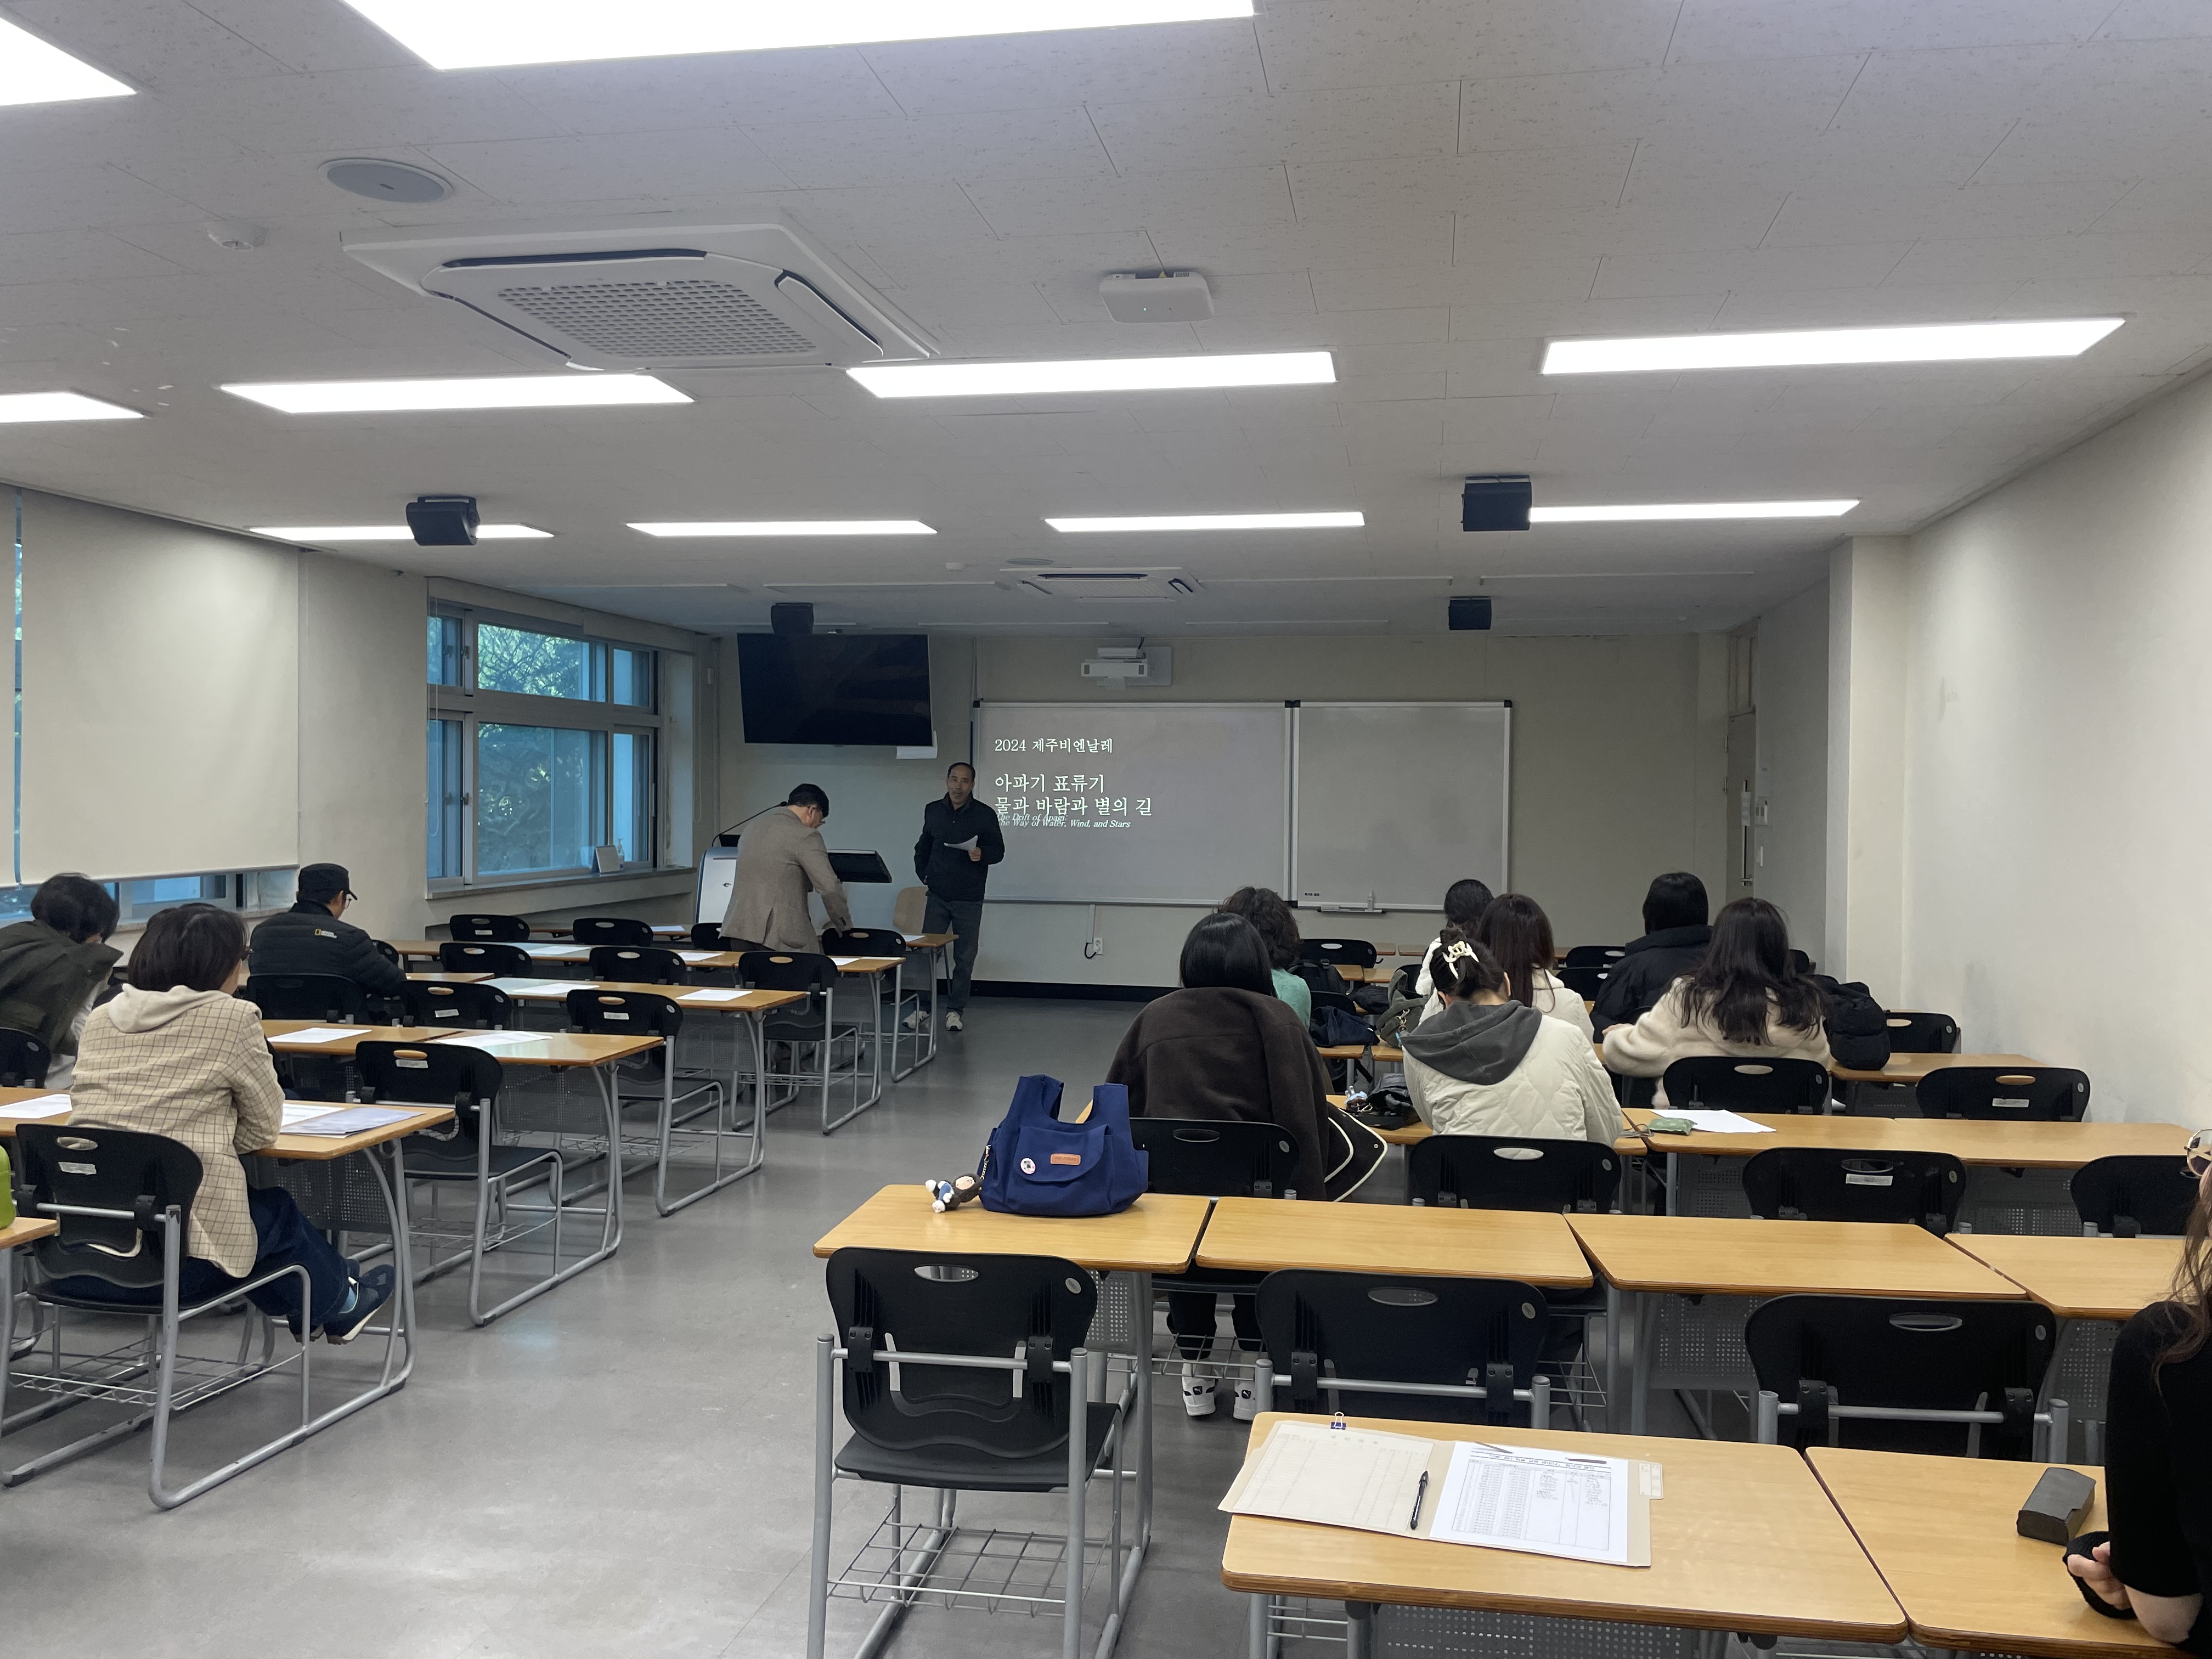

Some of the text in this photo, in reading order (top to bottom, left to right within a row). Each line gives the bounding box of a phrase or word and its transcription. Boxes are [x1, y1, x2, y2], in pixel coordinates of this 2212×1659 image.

[995, 738, 1113, 753] 2024 제주비엔날레
[995, 774, 1103, 793] 아파기 표류기
[995, 796, 1152, 816] 물과 바람과 별의 길
[1012, 813, 1030, 821] Drift
[1032, 813, 1042, 821] of
[1070, 819, 1091, 828] Wind,
[1093, 820, 1109, 828] and
